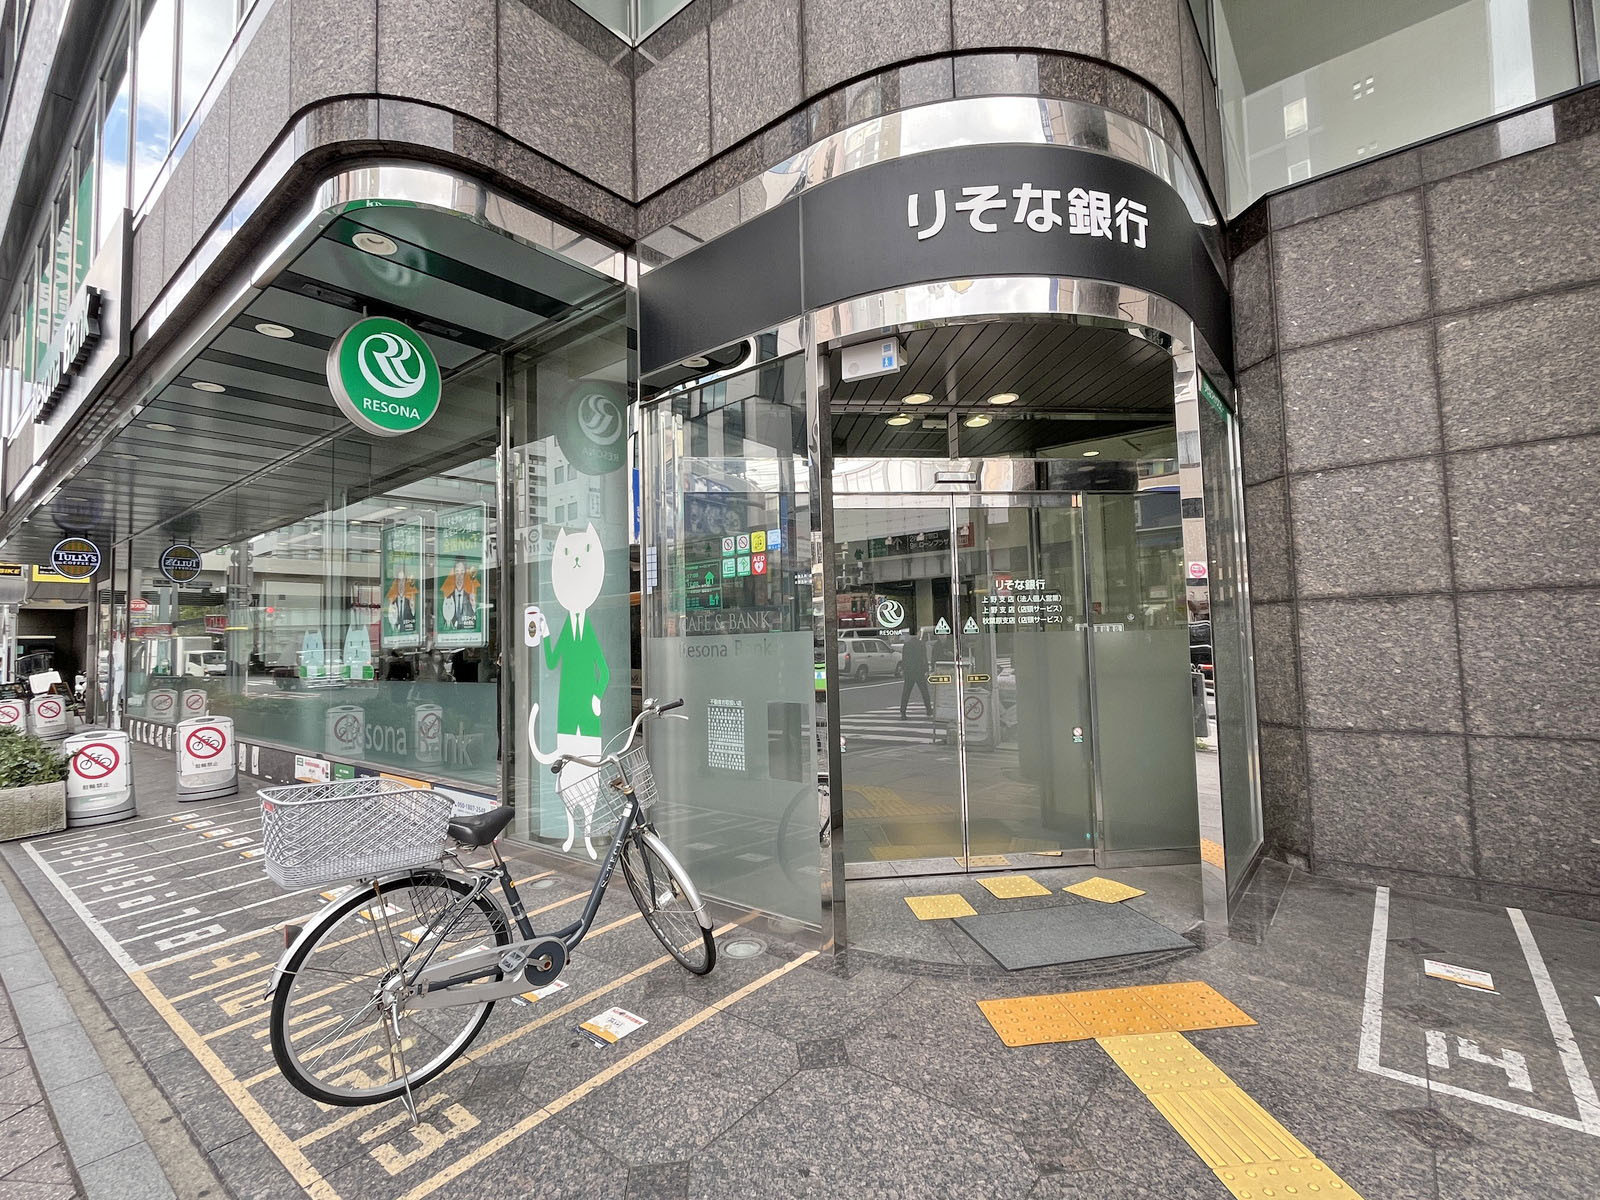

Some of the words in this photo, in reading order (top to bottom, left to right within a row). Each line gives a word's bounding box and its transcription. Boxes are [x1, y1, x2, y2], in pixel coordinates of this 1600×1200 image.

[907, 182, 1149, 249] りそな銀行
[362, 397, 421, 420] RESONA
[995, 579, 1046, 591] りそな銀行
[729, 611, 771, 632] BANK
[357, 723, 407, 755] sona
[71, 851, 124, 866] 3
[154, 923, 227, 952] 8
[1425, 1030, 1533, 1092] 14
[358, 1092, 481, 1176] 13
